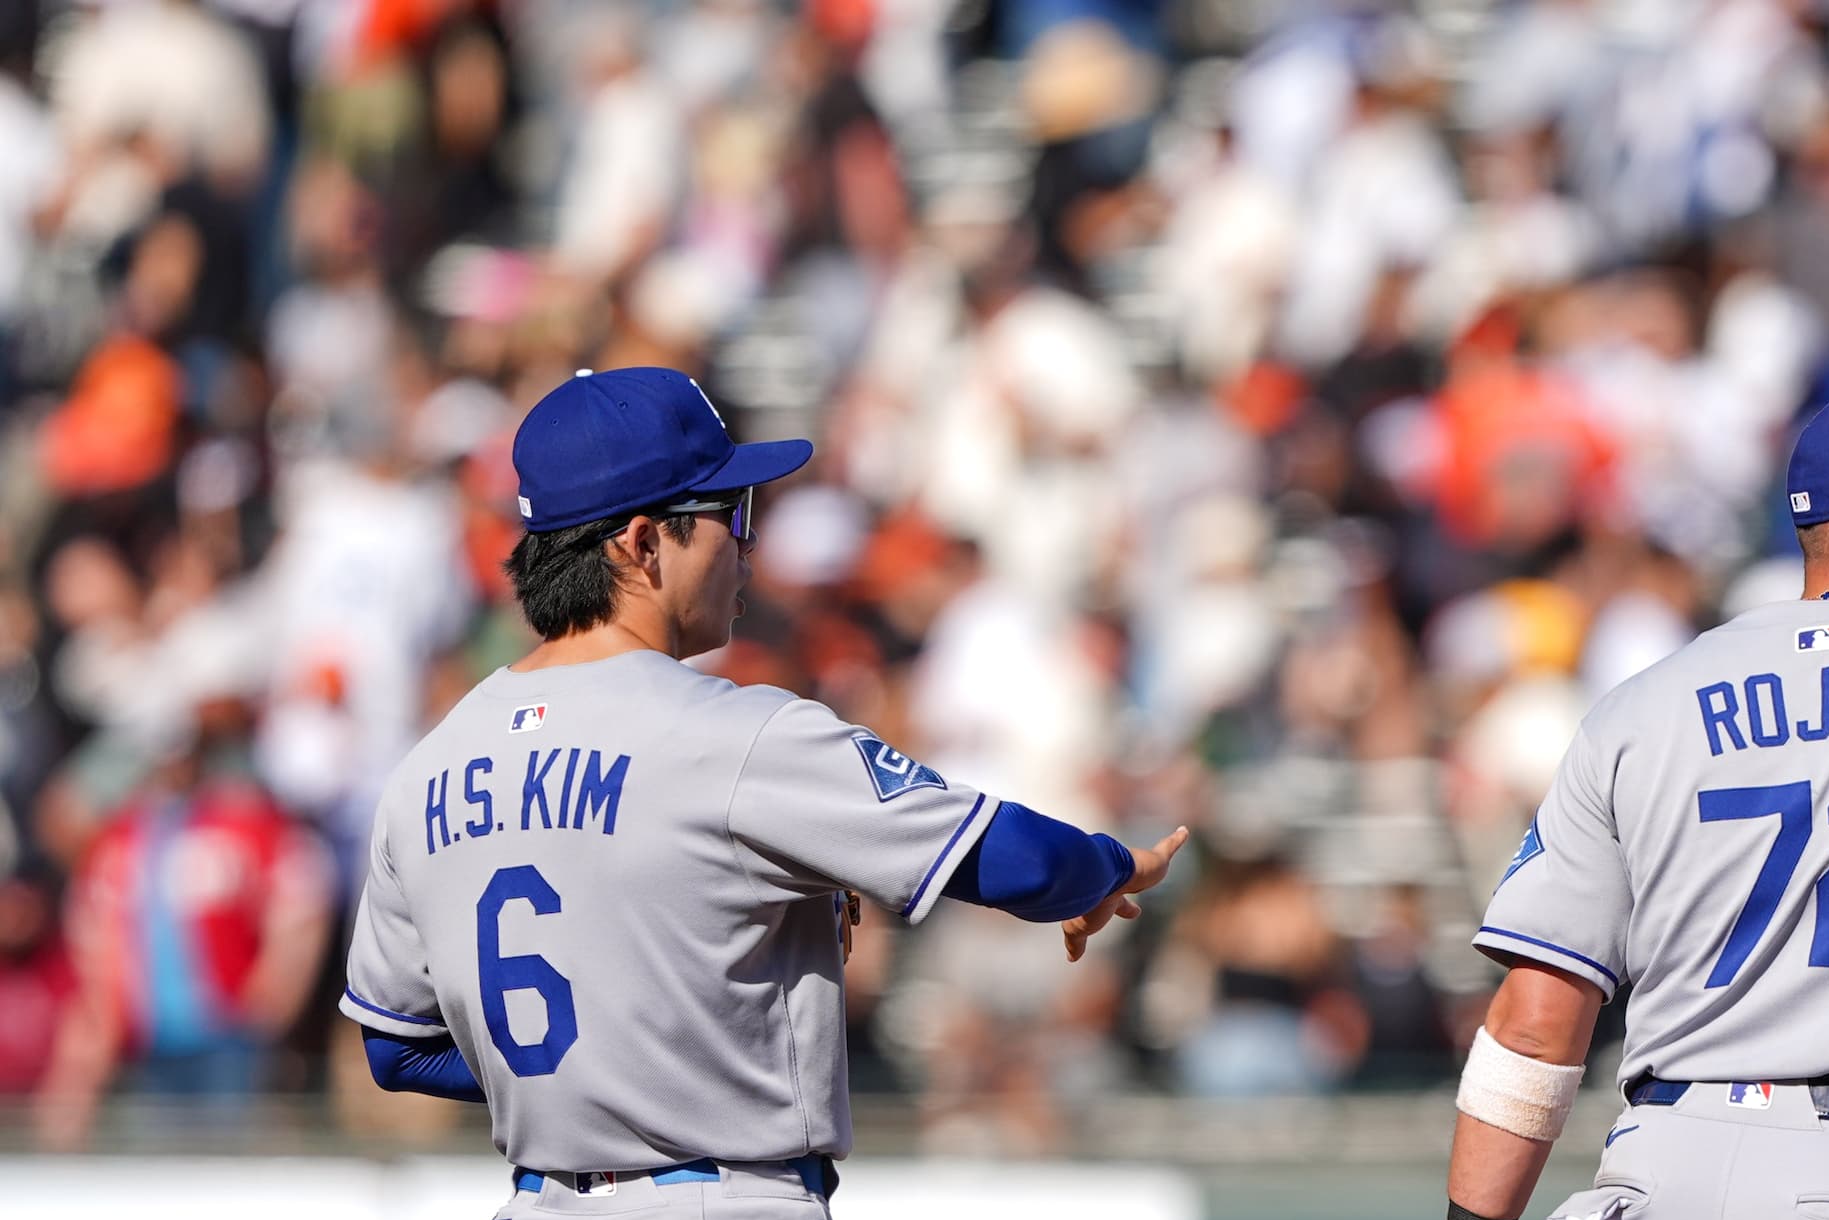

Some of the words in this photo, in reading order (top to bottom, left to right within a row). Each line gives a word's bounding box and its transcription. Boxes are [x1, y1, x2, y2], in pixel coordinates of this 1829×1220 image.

[426, 757, 503, 854] H.S.
[521, 748, 631, 835] KIM
[477, 865, 578, 1077] 6
